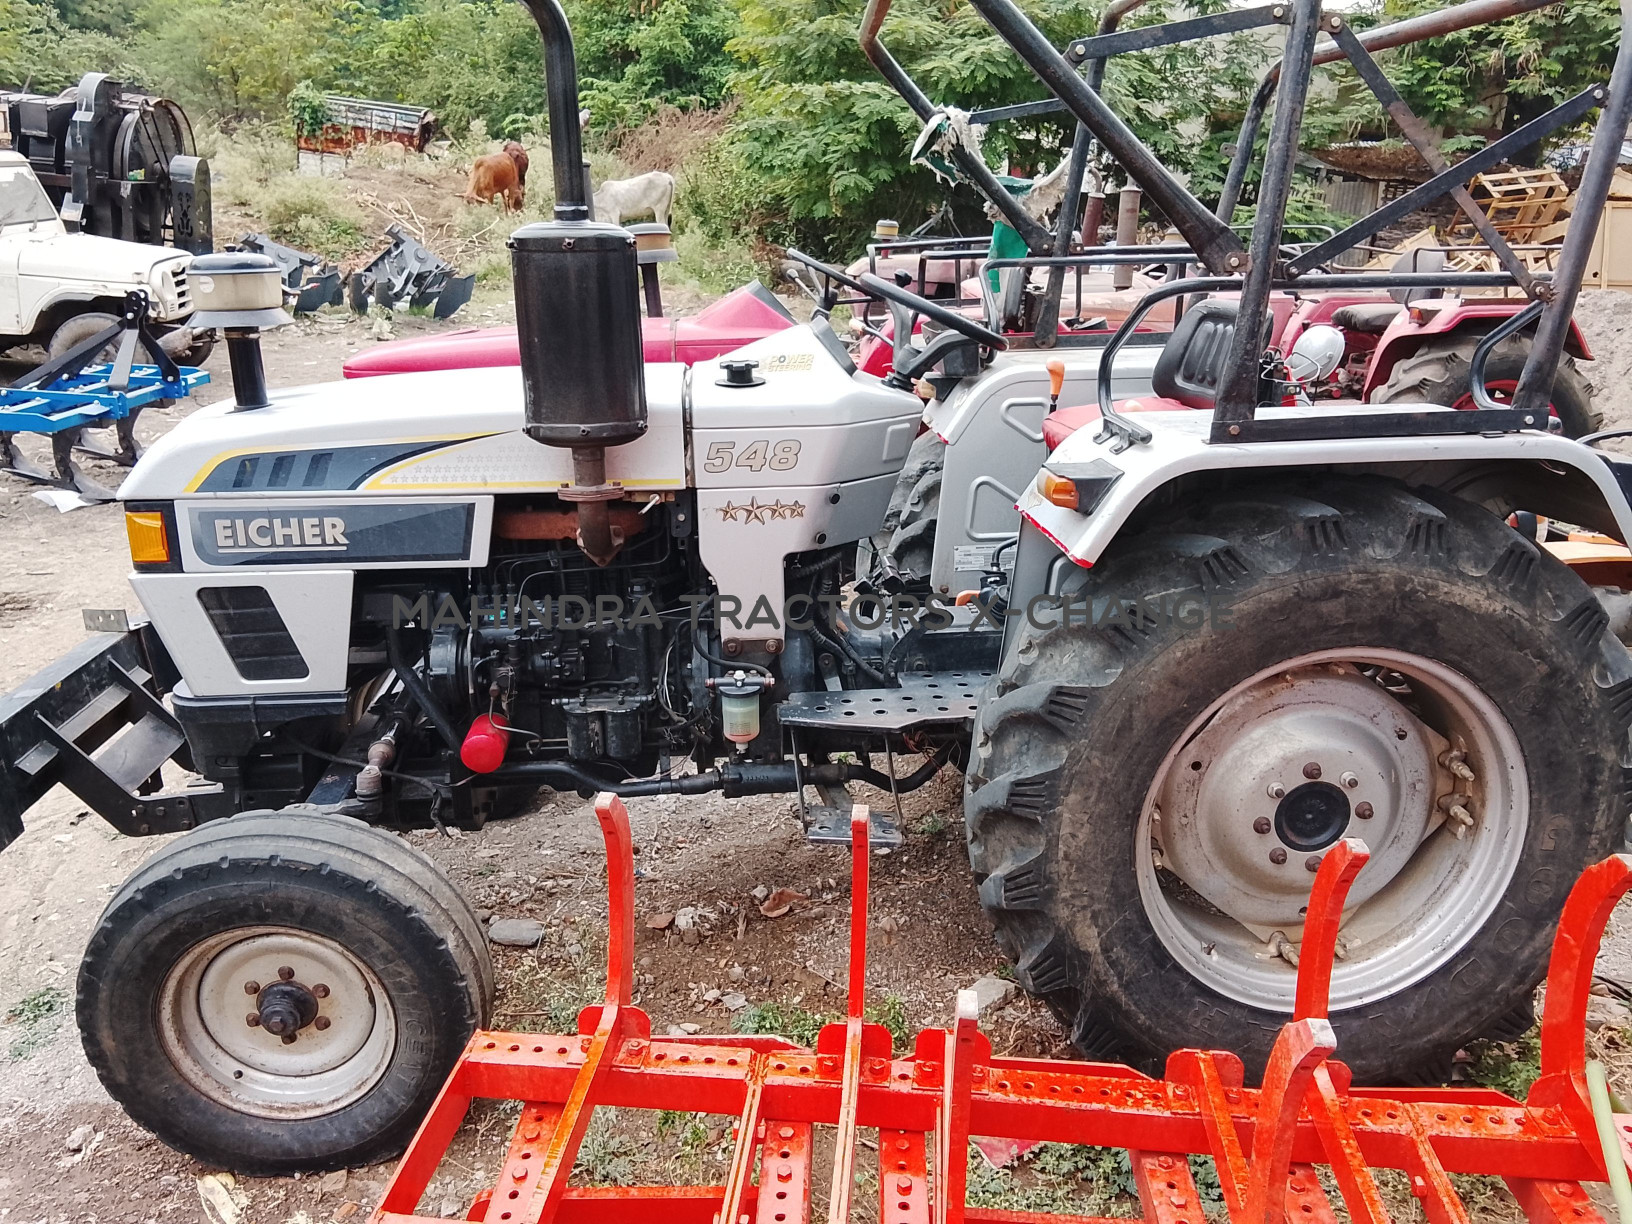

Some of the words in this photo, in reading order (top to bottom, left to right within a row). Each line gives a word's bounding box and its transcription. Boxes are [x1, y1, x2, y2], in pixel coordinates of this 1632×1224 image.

[770, 353, 815, 365] POWER
[703, 439, 802, 473] 548
[214, 517, 350, 547] EICHER
